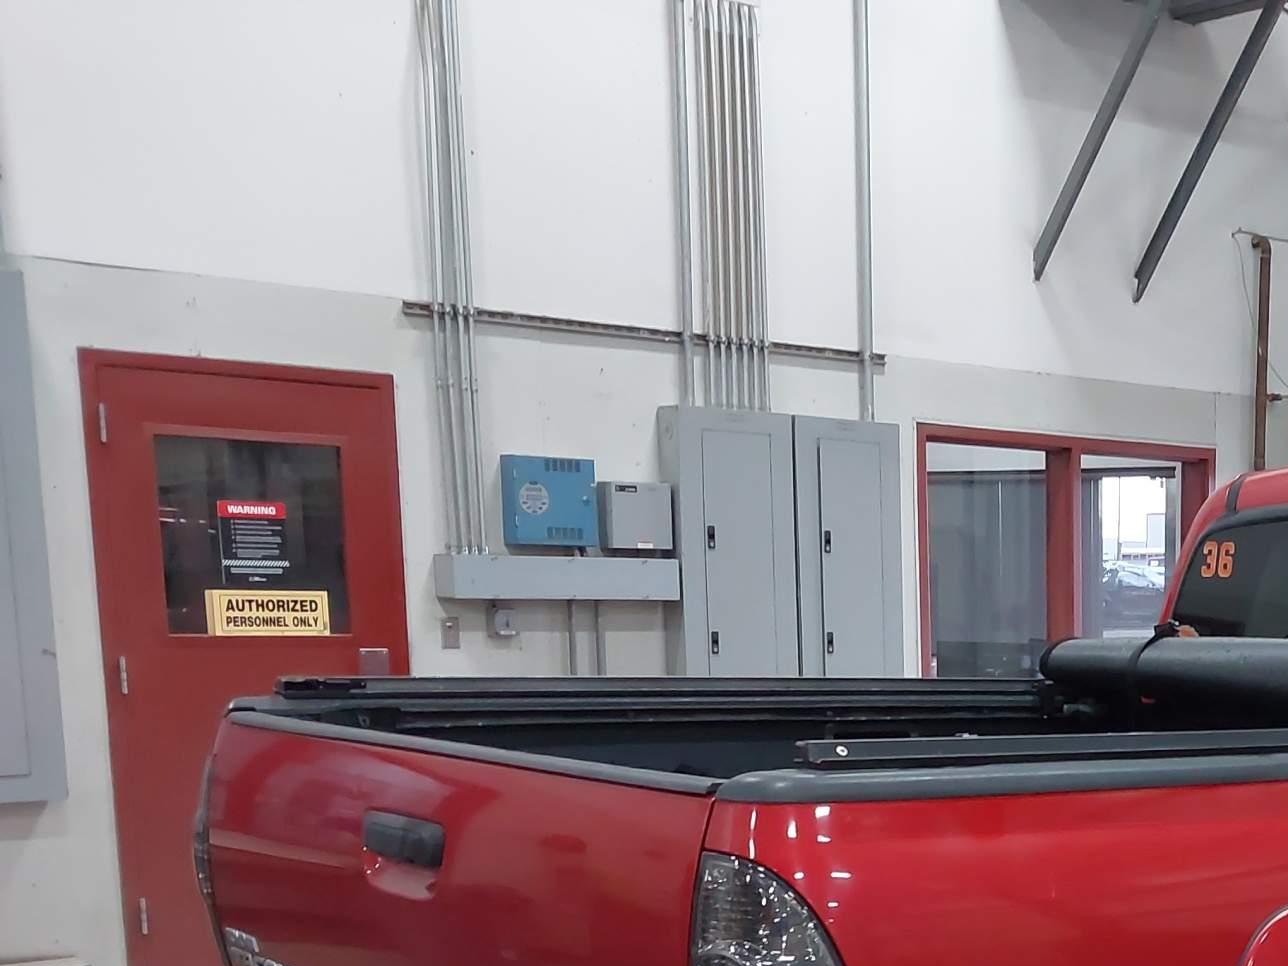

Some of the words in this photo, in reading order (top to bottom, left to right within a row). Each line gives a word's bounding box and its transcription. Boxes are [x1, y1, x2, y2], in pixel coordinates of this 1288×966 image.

[227, 504, 277, 515] WARNING
[1200, 540, 1236, 579] 36
[225, 598, 318, 613] AUTHORIZED
[226, 615, 289, 628] PERSONNEL
[292, 615, 319, 628] ONLY
